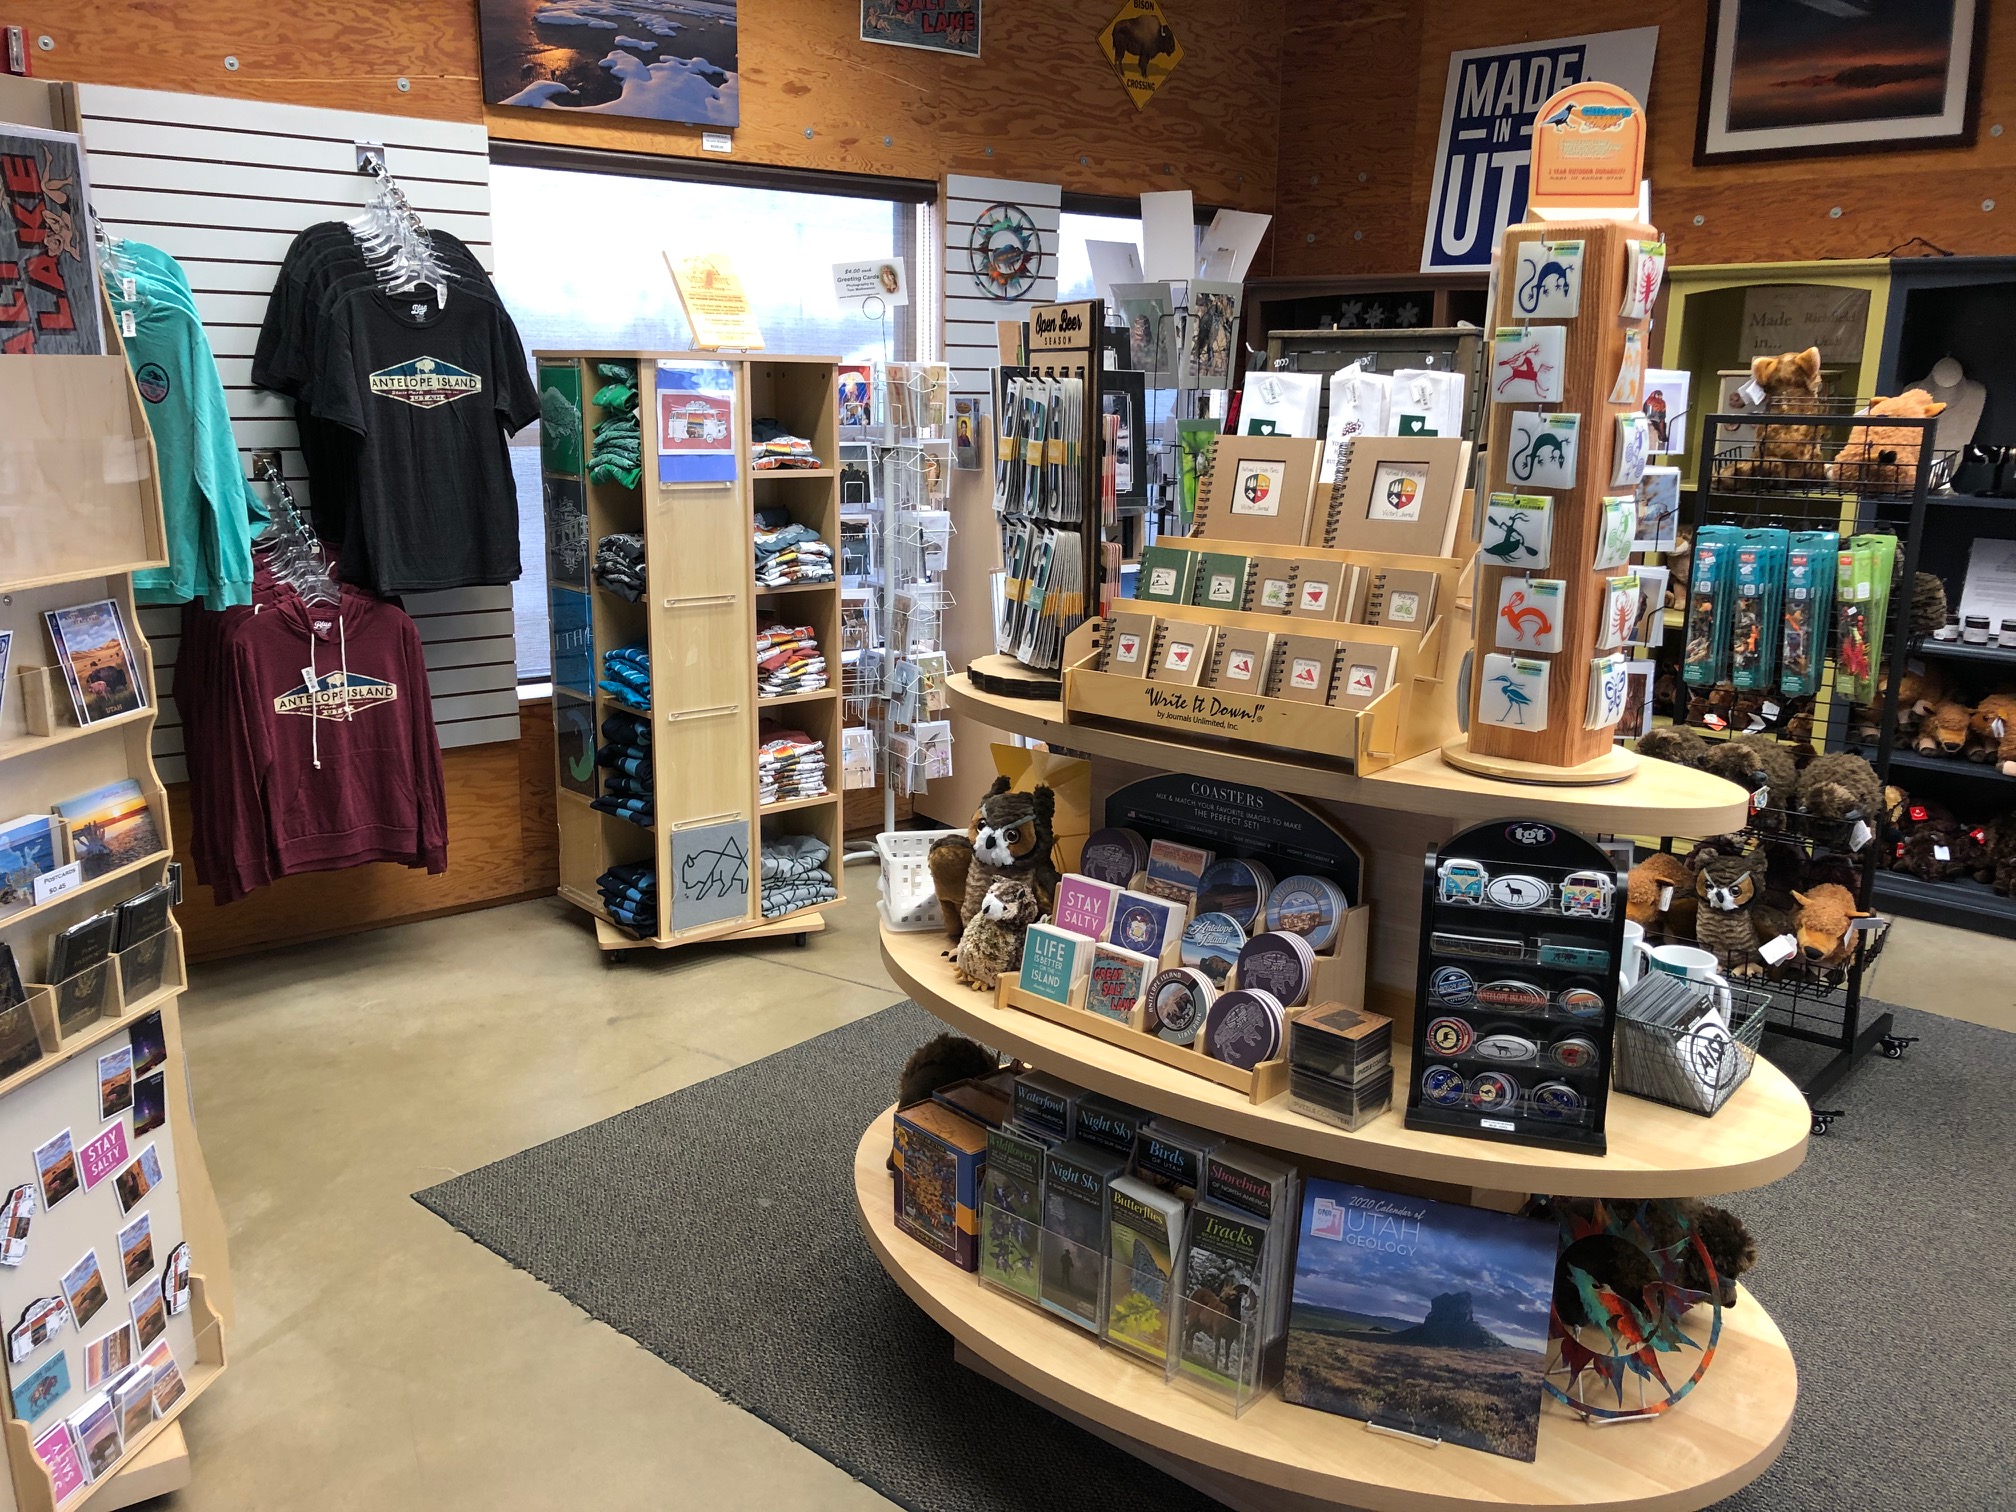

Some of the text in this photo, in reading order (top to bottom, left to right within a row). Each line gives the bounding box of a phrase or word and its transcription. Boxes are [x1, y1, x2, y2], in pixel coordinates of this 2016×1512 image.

[922, 12, 976, 33] LAKE
[1126, 77, 1156, 92] CROSSING
[1460, 52, 1580, 119] MADE
[1493, 117, 1512, 143] IN
[0, 153, 77, 331] LAKE
[1035, 308, 1082, 338] Open Beer
[1044, 336, 1072, 346] SEASON
[371, 376, 477, 389] ANTELOPE ISLAND
[279, 690, 343, 710] ANTELOPE
[346, 686, 393, 699] ISLAND
[1191, 694, 1206, 713] It
[1156, 710, 1239, 731] by Journals Unlimited, Inc.
[1190, 781, 1265, 809] COASTERS
[1156, 792, 1167, 800] MIX
[1174, 796, 1196, 807] MATCH
[1198, 801, 1215, 811] YOUR
[1216, 805, 1244, 818] FAVORITE
[1245, 812, 1271, 824] IMAGES
[1272, 817, 1282, 826] TO
[1283, 821, 1302, 831] MAKE
[1194, 808, 1208, 819] THE
[1210, 811, 1242, 827] PERFECT
[1514, 827, 1546, 844] tgt
[43, 867, 77, 885] POSTCARDS
[48, 882, 67, 894] $0.45
[1067, 891, 1102, 914] STAY
[1064, 910, 1099, 931] SALTY
[1189, 920, 1234, 935] Antelope
[1035, 936, 1066, 962] LIFE
[1197, 933, 1229, 946] Island
[1034, 954, 1063, 970] IS BETTER
[1093, 966, 1124, 981] GREAT
[1031, 969, 1060, 987] ISLAND
[1102, 981, 1126, 996] SALT
[1110, 997, 1136, 1011] LAKE
[1017, 1085, 1065, 1113] Waterfowl
[1080, 1109, 1134, 1143] Night Sky
[88, 1129, 117, 1161] STAY
[988, 1130, 1038, 1164] Wildflowers
[1150, 1140, 1185, 1166] Birds
[91, 1145, 120, 1176] SALTY
[1163, 1160, 1182, 1173] UTAH
[1049, 1160, 1080, 1183] Night
[1080, 1173, 1101, 1195] Sky
[1211, 1164, 1271, 1199] Shorebirds
[1113, 1191, 1163, 1225] Butterflies
[1221, 1185, 1242, 1197] NORTH
[1242, 1193, 1269, 1208] AMERICA
[1348, 1196, 1427, 1220] 2020 Calendar of
[1205, 1216, 1254, 1246] Tracks
[1347, 1208, 1420, 1243] UTAH
[1346, 1233, 1417, 1257] GEOLOGY
